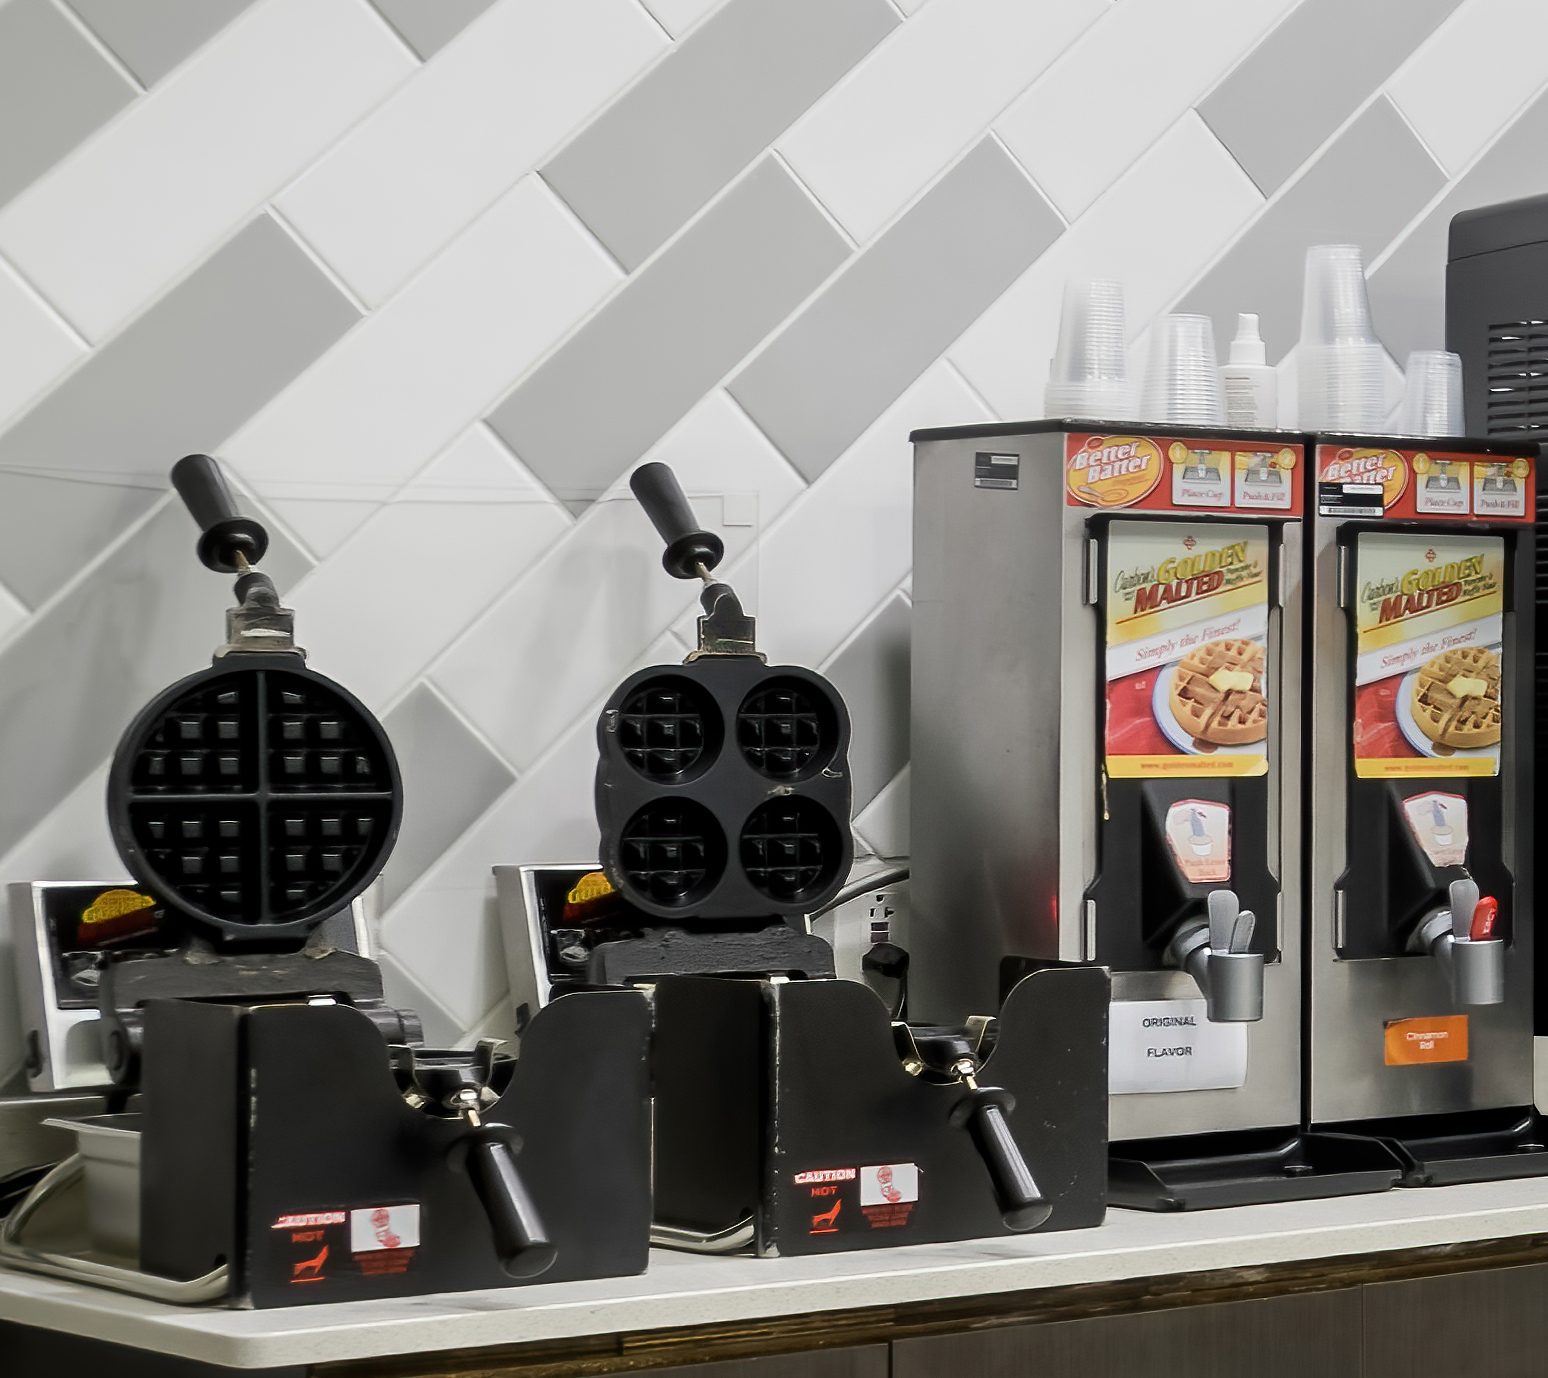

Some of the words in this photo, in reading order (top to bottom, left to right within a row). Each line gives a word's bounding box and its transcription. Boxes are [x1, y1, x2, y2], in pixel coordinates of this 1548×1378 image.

[1074, 441, 1141, 470] Better
[1087, 455, 1152, 484] Batter
[1329, 453, 1387, 480] Better
[1157, 540, 1249, 584] GOLDEN
[1401, 553, 1485, 596] GOLDEN
[1133, 569, 1225, 614] MALTED
[1378, 581, 1463, 624] MALTED
[1136, 639, 1178, 662] Simply
[1179, 633, 1199, 648] the
[1381, 646, 1418, 669] Simply
[1420, 641, 1438, 655] the
[1142, 1015, 1197, 1028] ORIGINAL
[1147, 1046, 1193, 1058] FLAVOR
[795, 1168, 856, 1184] CAUTION
[811, 1185, 838, 1197] HOT
